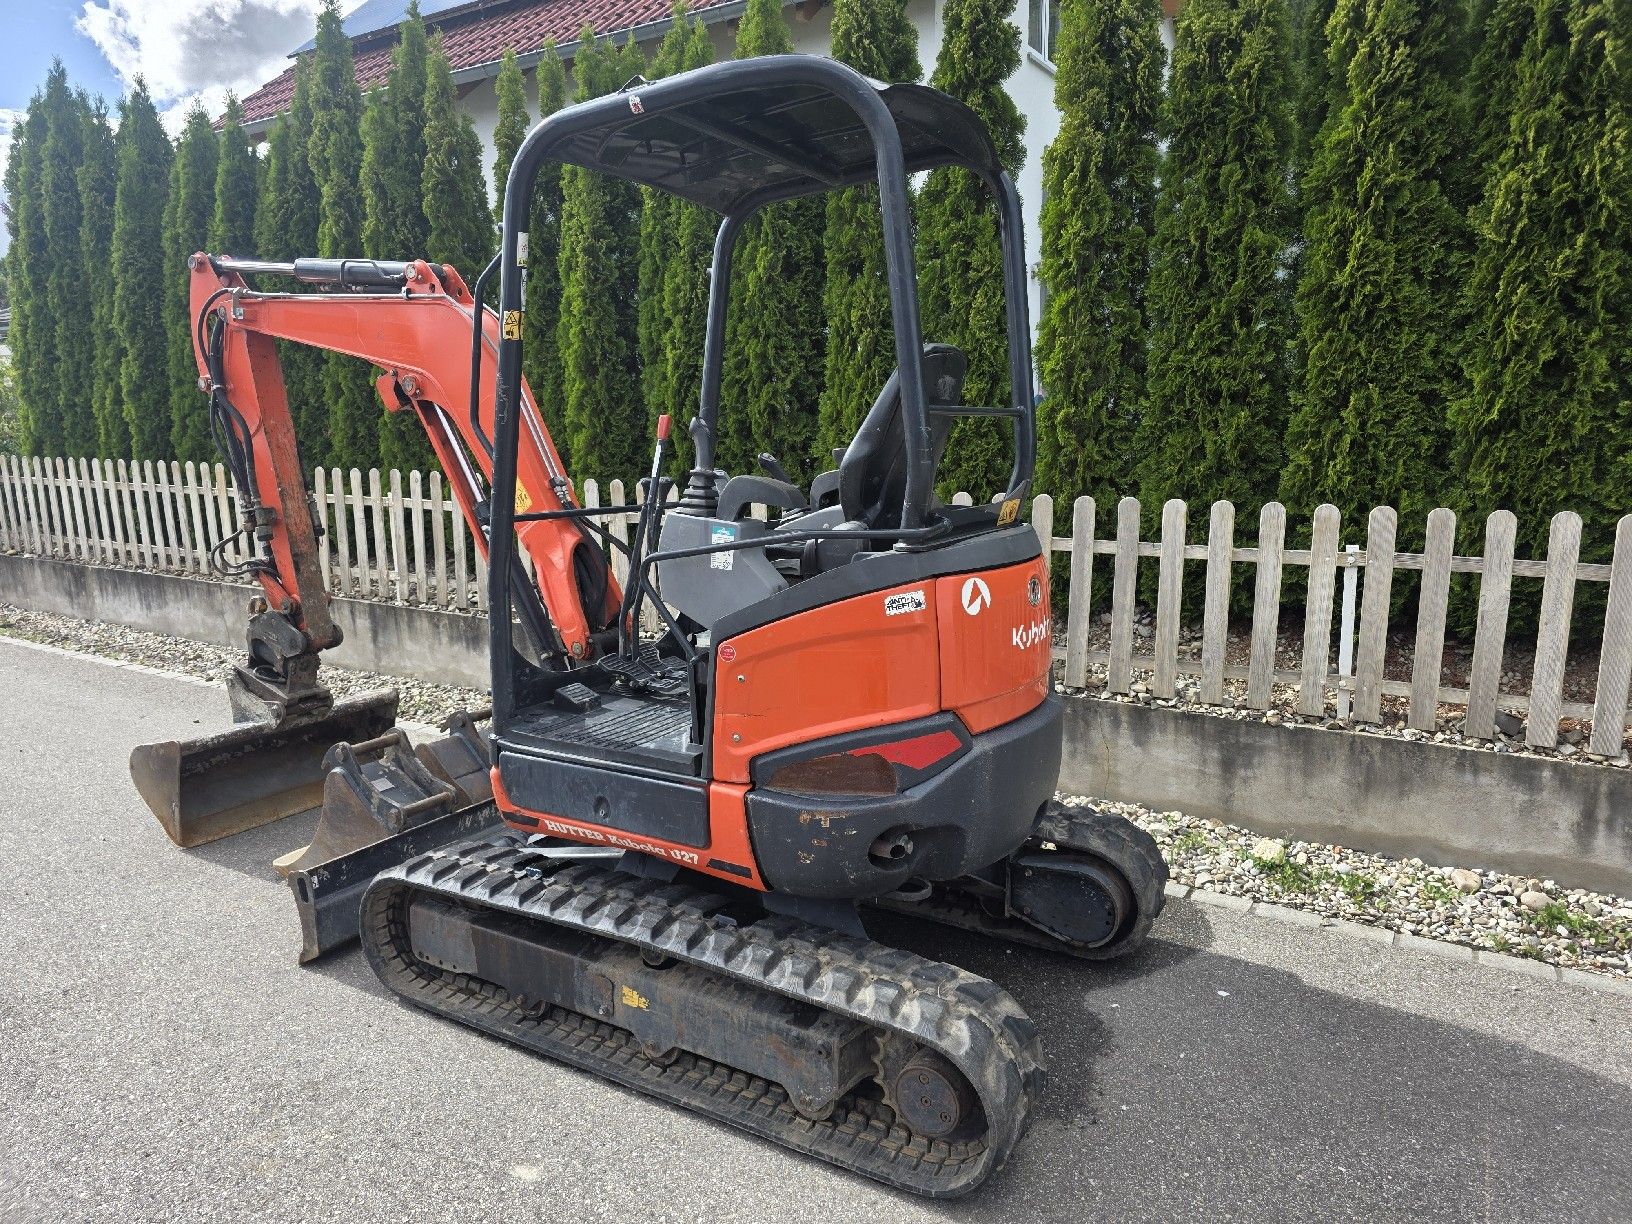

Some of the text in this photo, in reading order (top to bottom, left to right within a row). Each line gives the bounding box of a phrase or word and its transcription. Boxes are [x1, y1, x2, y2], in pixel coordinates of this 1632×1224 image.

[887, 602, 911, 611] THEFT
[544, 819, 699, 865] HUTTER Kubota U27
